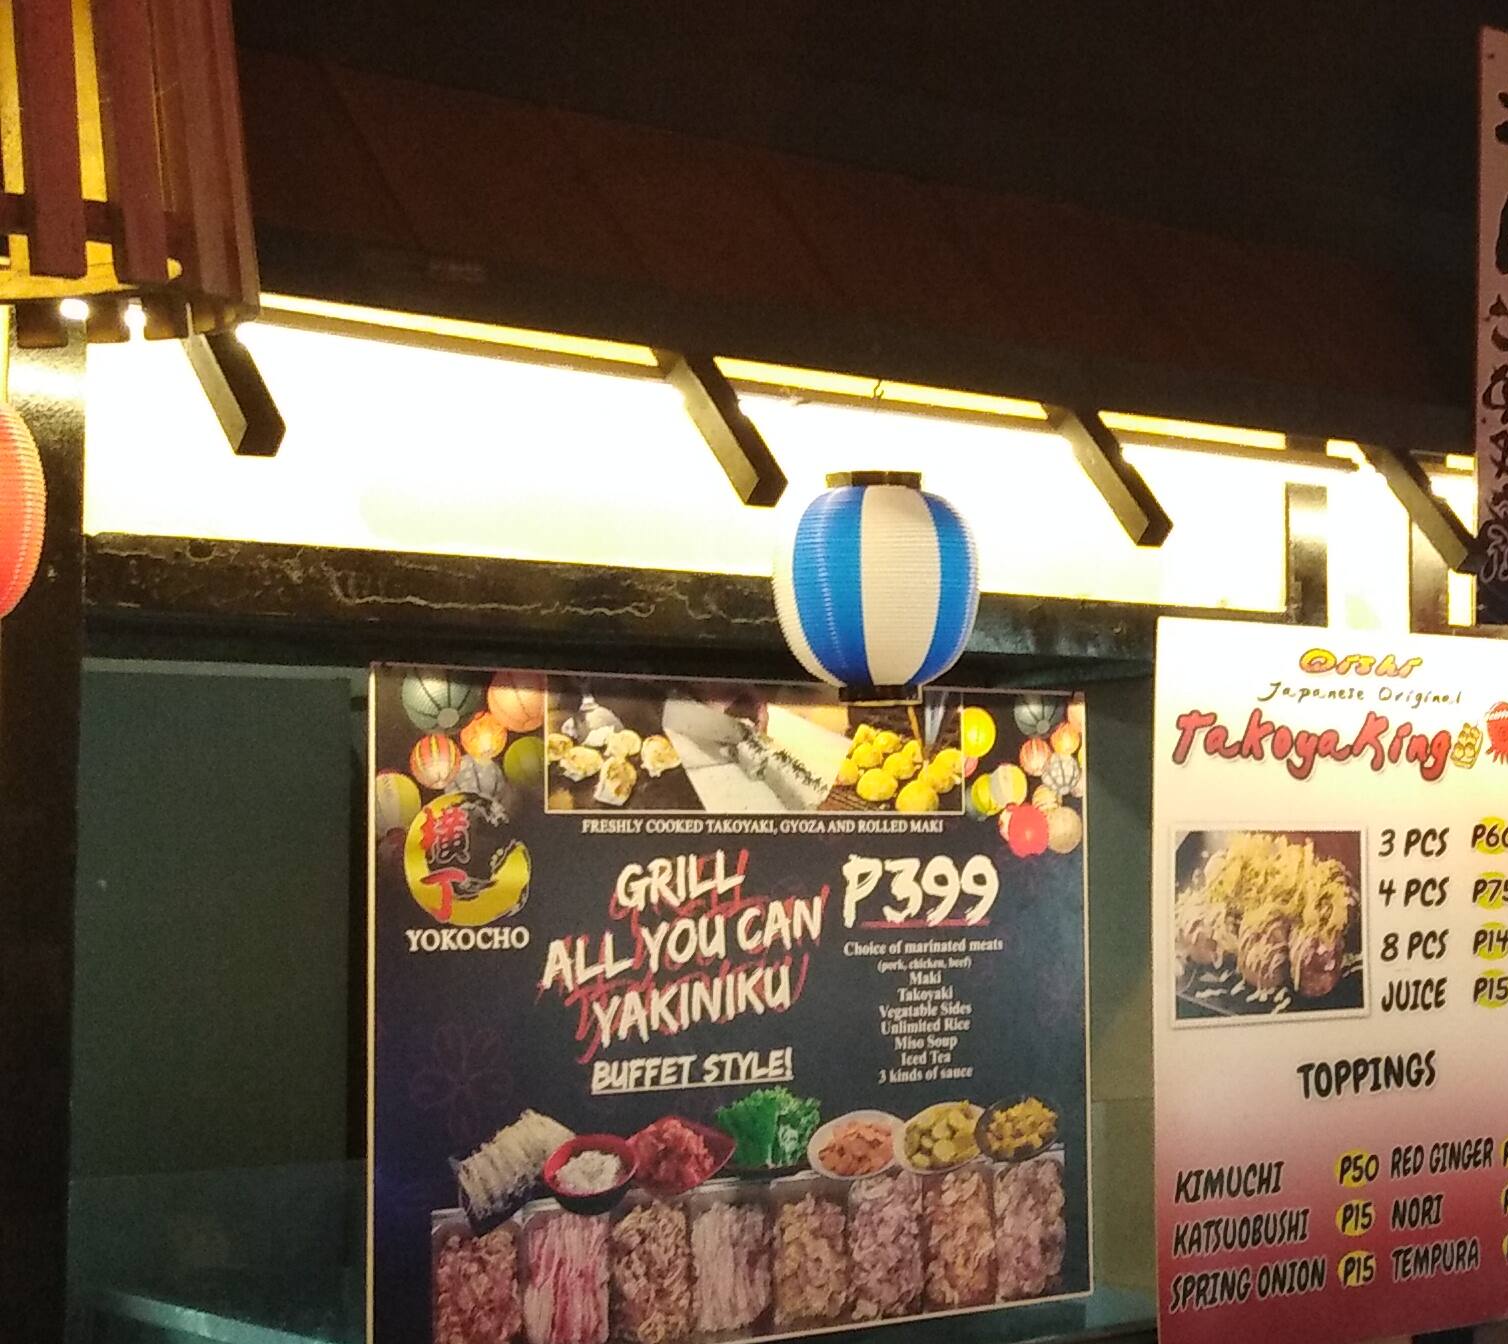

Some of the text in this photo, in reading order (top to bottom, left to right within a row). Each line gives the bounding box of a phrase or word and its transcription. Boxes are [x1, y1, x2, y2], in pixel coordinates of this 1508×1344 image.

[1257, 681, 1462, 708] Japanese Original
[581, 819, 944, 836] FRESHLY COOKED TAKOYAKI, GYOZA AND ROLLED MAKI
[1378, 829, 1395, 857] 3
[1404, 827, 1450, 857] PCS
[616, 849, 745, 911] GRILL
[842, 854, 1000, 928] P399
[1378, 879, 1396, 907] 4
[1404, 877, 1450, 907] PCS
[406, 926, 530, 952] YOKOCHO
[541, 896, 823, 992] ALL YOU CAN
[843, 938, 1004, 956] Choice of marinated meats
[1380, 932, 1399, 962] 8
[1407, 929, 1450, 960] PCS
[897, 985, 954, 1003] Takoyaki
[909, 971, 942, 985] Maki
[1381, 977, 1447, 1012] JUICE
[592, 964, 791, 1048] YAKINIKU
[940, 1001, 972, 1016] Sides
[881, 1017, 971, 1035] Unlimited Rice
[895, 1034, 958, 1050] Miso Soup
[592, 1046, 794, 1092] BUFFET STYLE!
[879, 1065, 974, 1084] 3 kinds of sauce
[901, 1050, 952, 1066] Iced Tea
[1297, 1049, 1437, 1099] TOPPINGS
[1390, 1146, 1425, 1179] RED
[1429, 1137, 1495, 1175] GINGER
[1174, 1155, 1379, 1204] KIMUCHI P50
[1391, 1194, 1444, 1230] NORI
[1173, 1203, 1374, 1257] KATSUOBUSHI P15
[1392, 1239, 1480, 1283] TEMPURA
[1170, 1256, 1375, 1313] SPRING ONION P15
